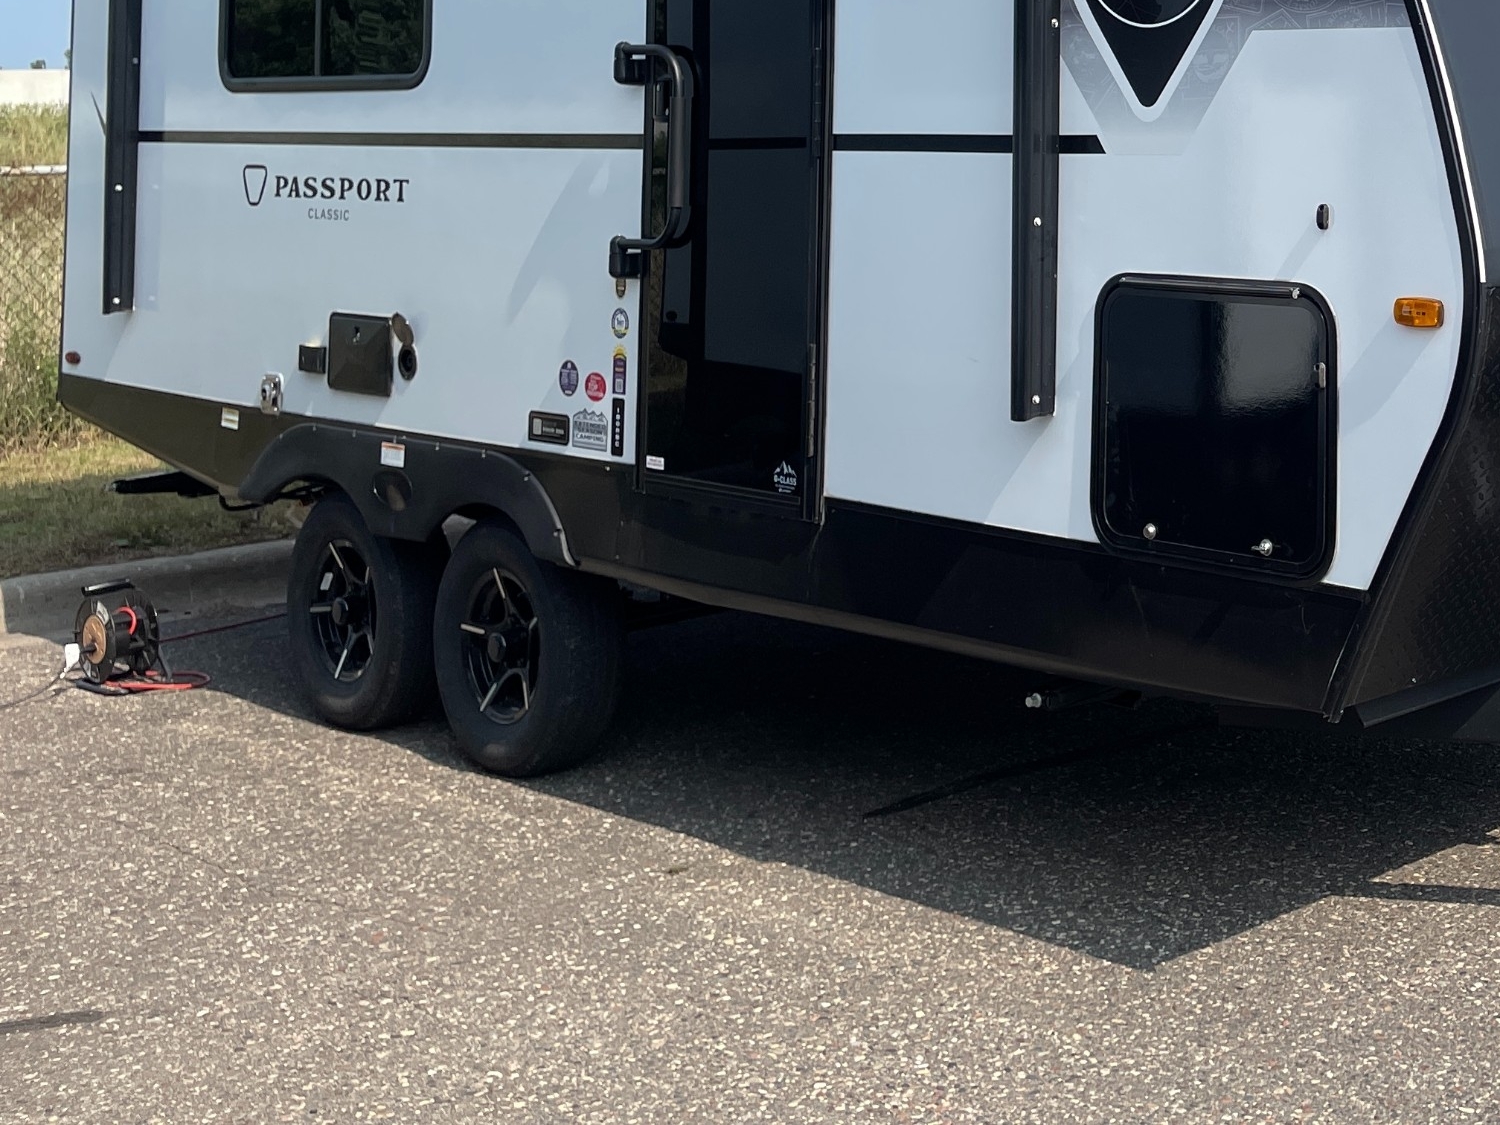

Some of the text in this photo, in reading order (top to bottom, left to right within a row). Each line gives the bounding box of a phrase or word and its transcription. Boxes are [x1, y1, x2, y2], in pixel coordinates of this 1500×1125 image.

[274, 175, 410, 202] PASSPORT
[307, 208, 350, 221] CLASSIC
[575, 433, 604, 442] CAMPING
